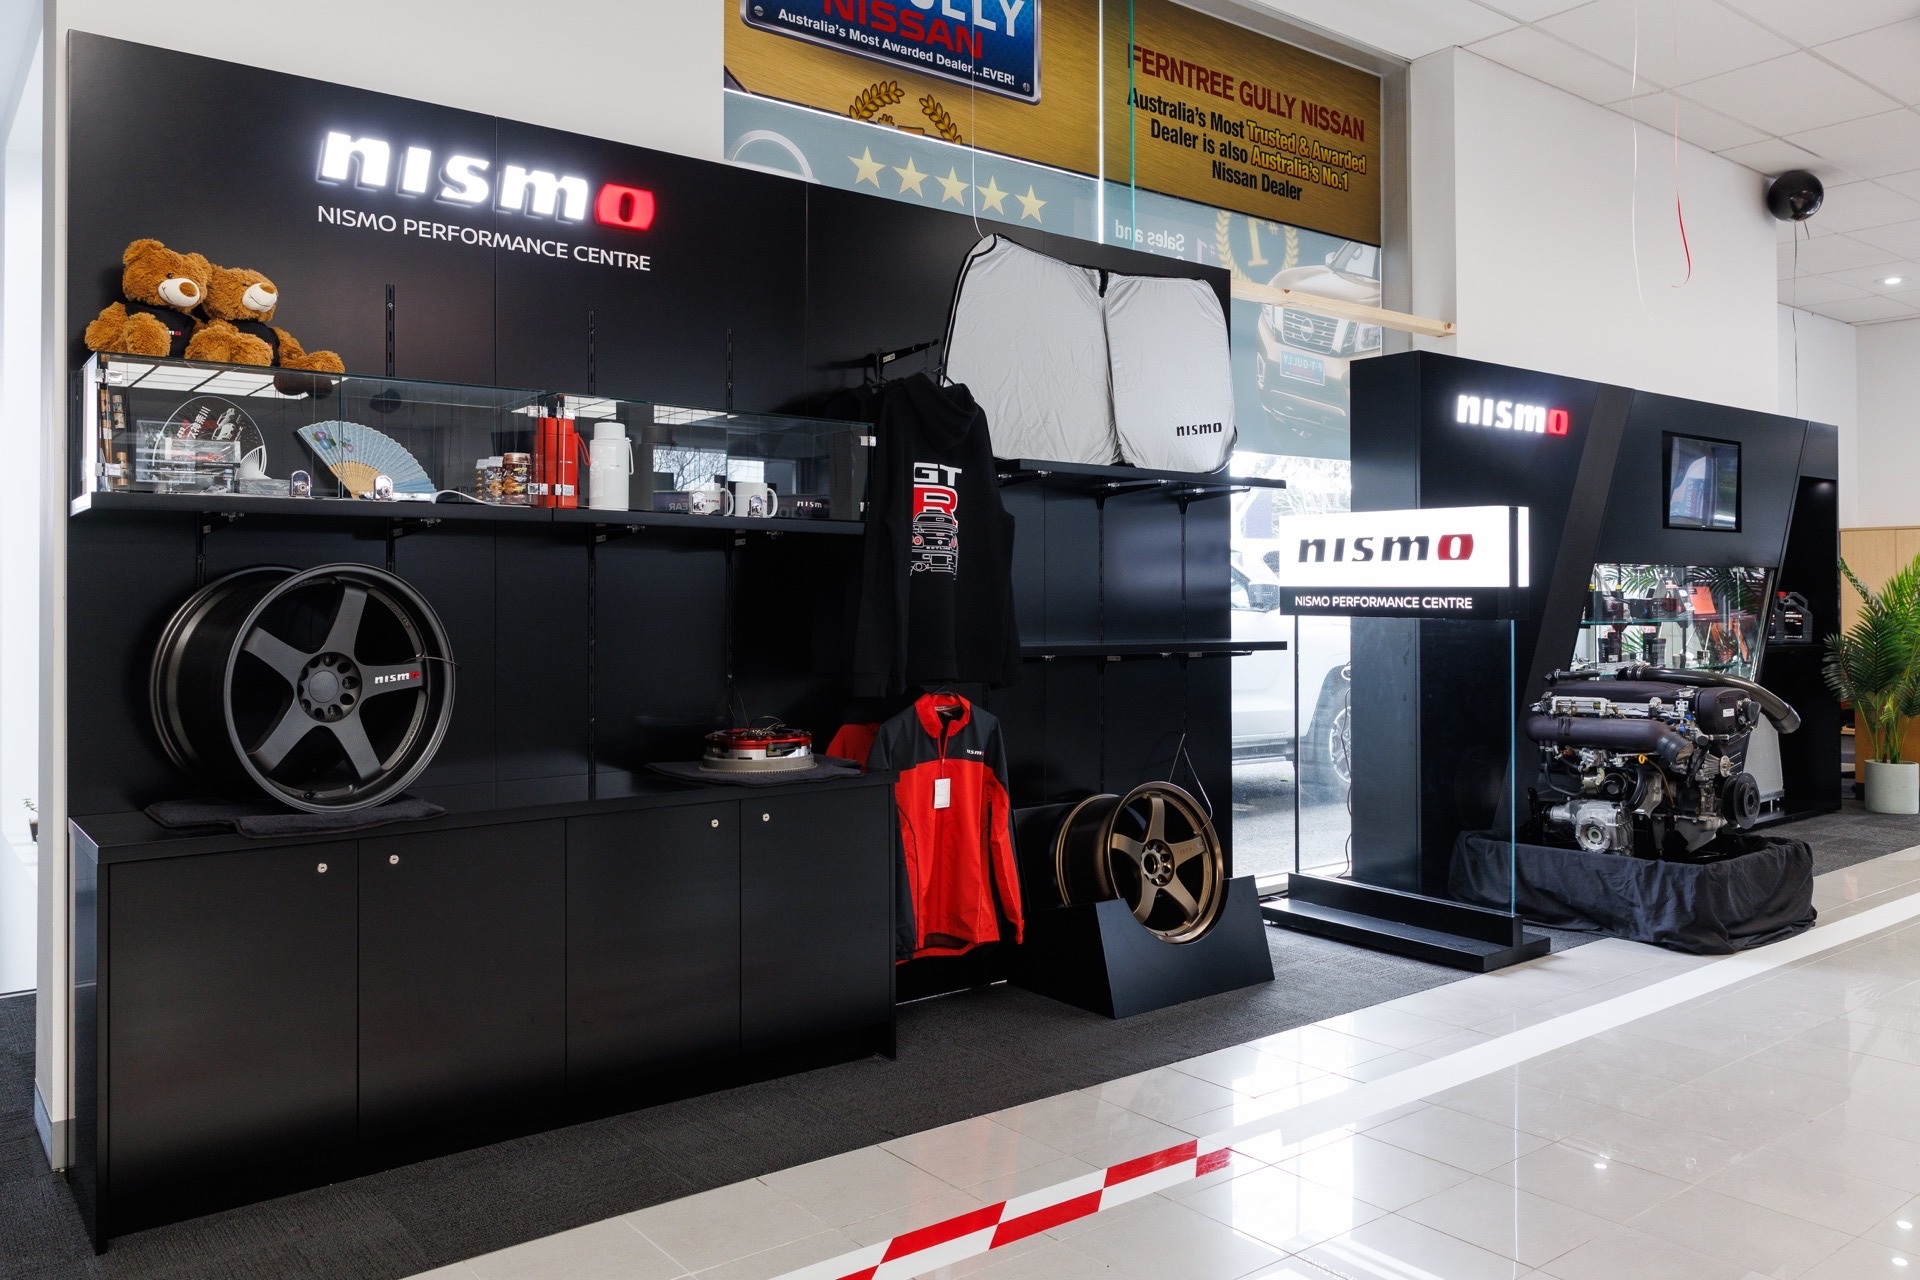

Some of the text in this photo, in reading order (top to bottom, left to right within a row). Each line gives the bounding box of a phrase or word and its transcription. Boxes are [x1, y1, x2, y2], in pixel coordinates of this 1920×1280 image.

[778, 8, 847, 37] Australia's
[849, 28, 880, 47] Most
[882, 38, 934, 63] Awarded
[823, 0, 983, 58] NISSAN
[1127, 42, 1365, 142] FERNTREE GULLY NISSAN
[1127, 87, 1366, 175] Australia's Most Trusted & Awarded
[1150, 118, 1349, 191] Dealer is also Australia's No.1
[318, 131, 655, 232] nismo
[1212, 159, 1303, 201] Nissan Dealer
[317, 205, 651, 272] NISMO PERFORMANCE CENTRE
[1176, 421, 1223, 437] nismo
[1456, 394, 1569, 436] nismo
[913, 462, 963, 487] GT
[796, 500, 829, 511] nism
[912, 483, 959, 527] R
[1298, 533, 1474, 563] nismo
[1295, 595, 1473, 609] NISMO PERFORMANCE CENTRE
[374, 671, 420, 684] nismo
